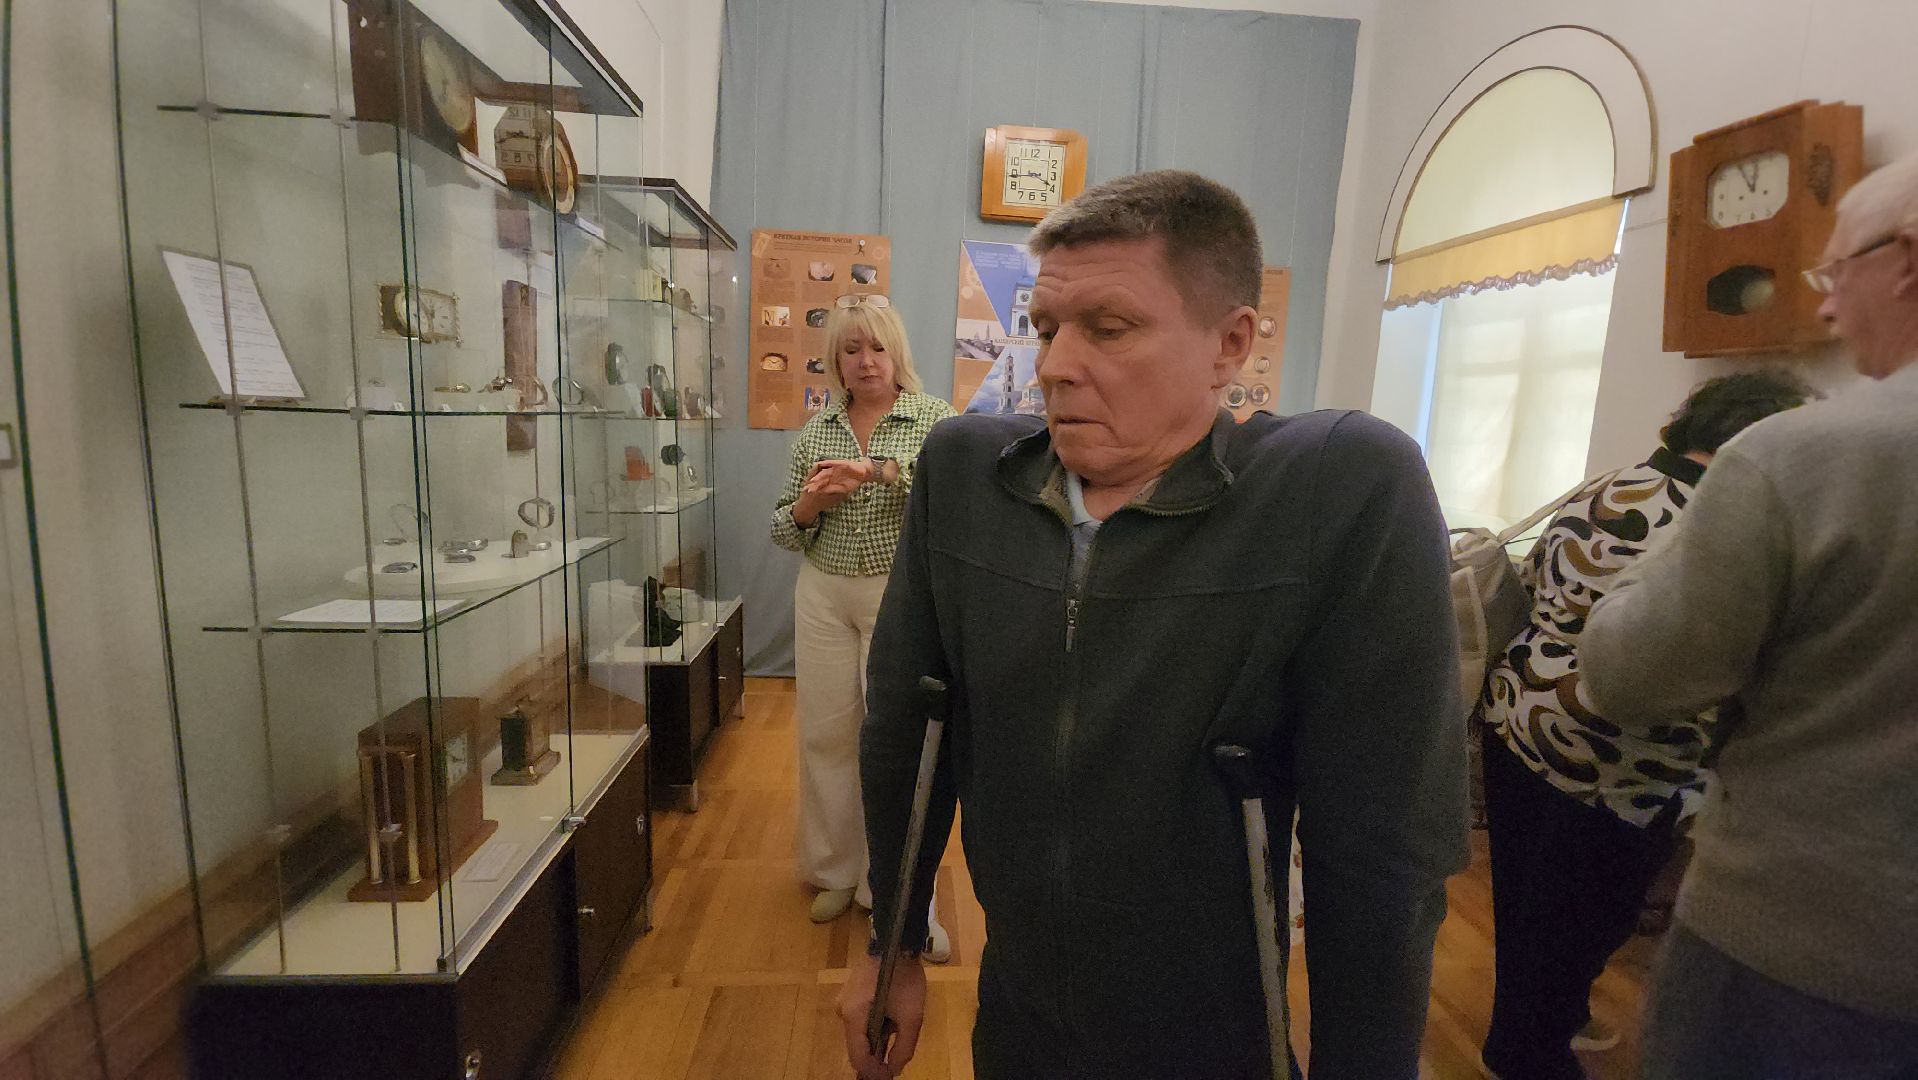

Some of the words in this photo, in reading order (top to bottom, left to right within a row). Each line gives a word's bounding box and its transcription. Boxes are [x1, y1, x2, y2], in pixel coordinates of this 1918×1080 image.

[1021, 148, 1027, 157] 11
[1031, 149, 1040, 158] 12
[1011, 157, 1019, 166] 10
[1051, 160, 1057, 168] 2
[1051, 172, 1056, 181] 3
[1011, 181, 1016, 190] 8
[1050, 184, 1055, 193] 4
[1018, 191, 1023, 199] 7
[1029, 192, 1035, 200] 6
[1041, 193, 1047, 201] 5
